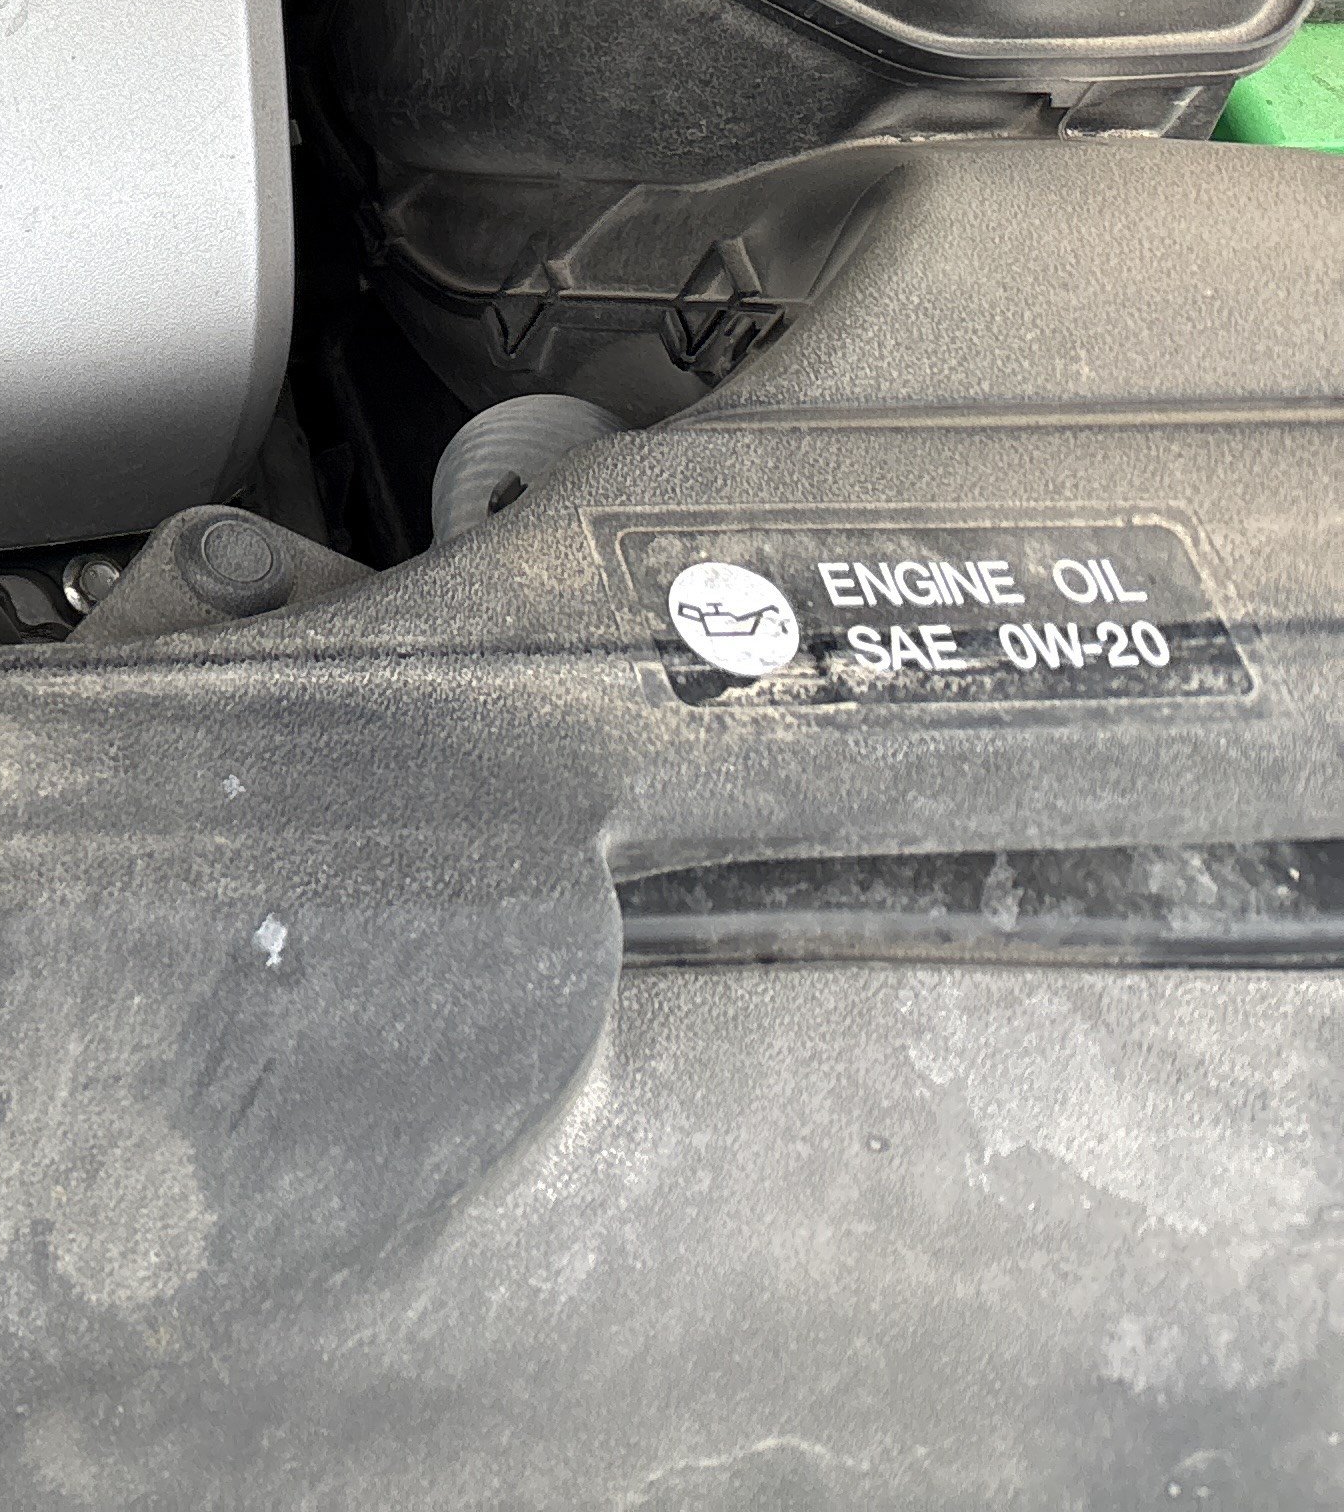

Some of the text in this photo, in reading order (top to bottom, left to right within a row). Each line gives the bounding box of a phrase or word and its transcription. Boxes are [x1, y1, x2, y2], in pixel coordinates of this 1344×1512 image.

[816, 557, 1149, 607] ENGINE OIL
[846, 619, 1171, 672] SAE 0W-20
